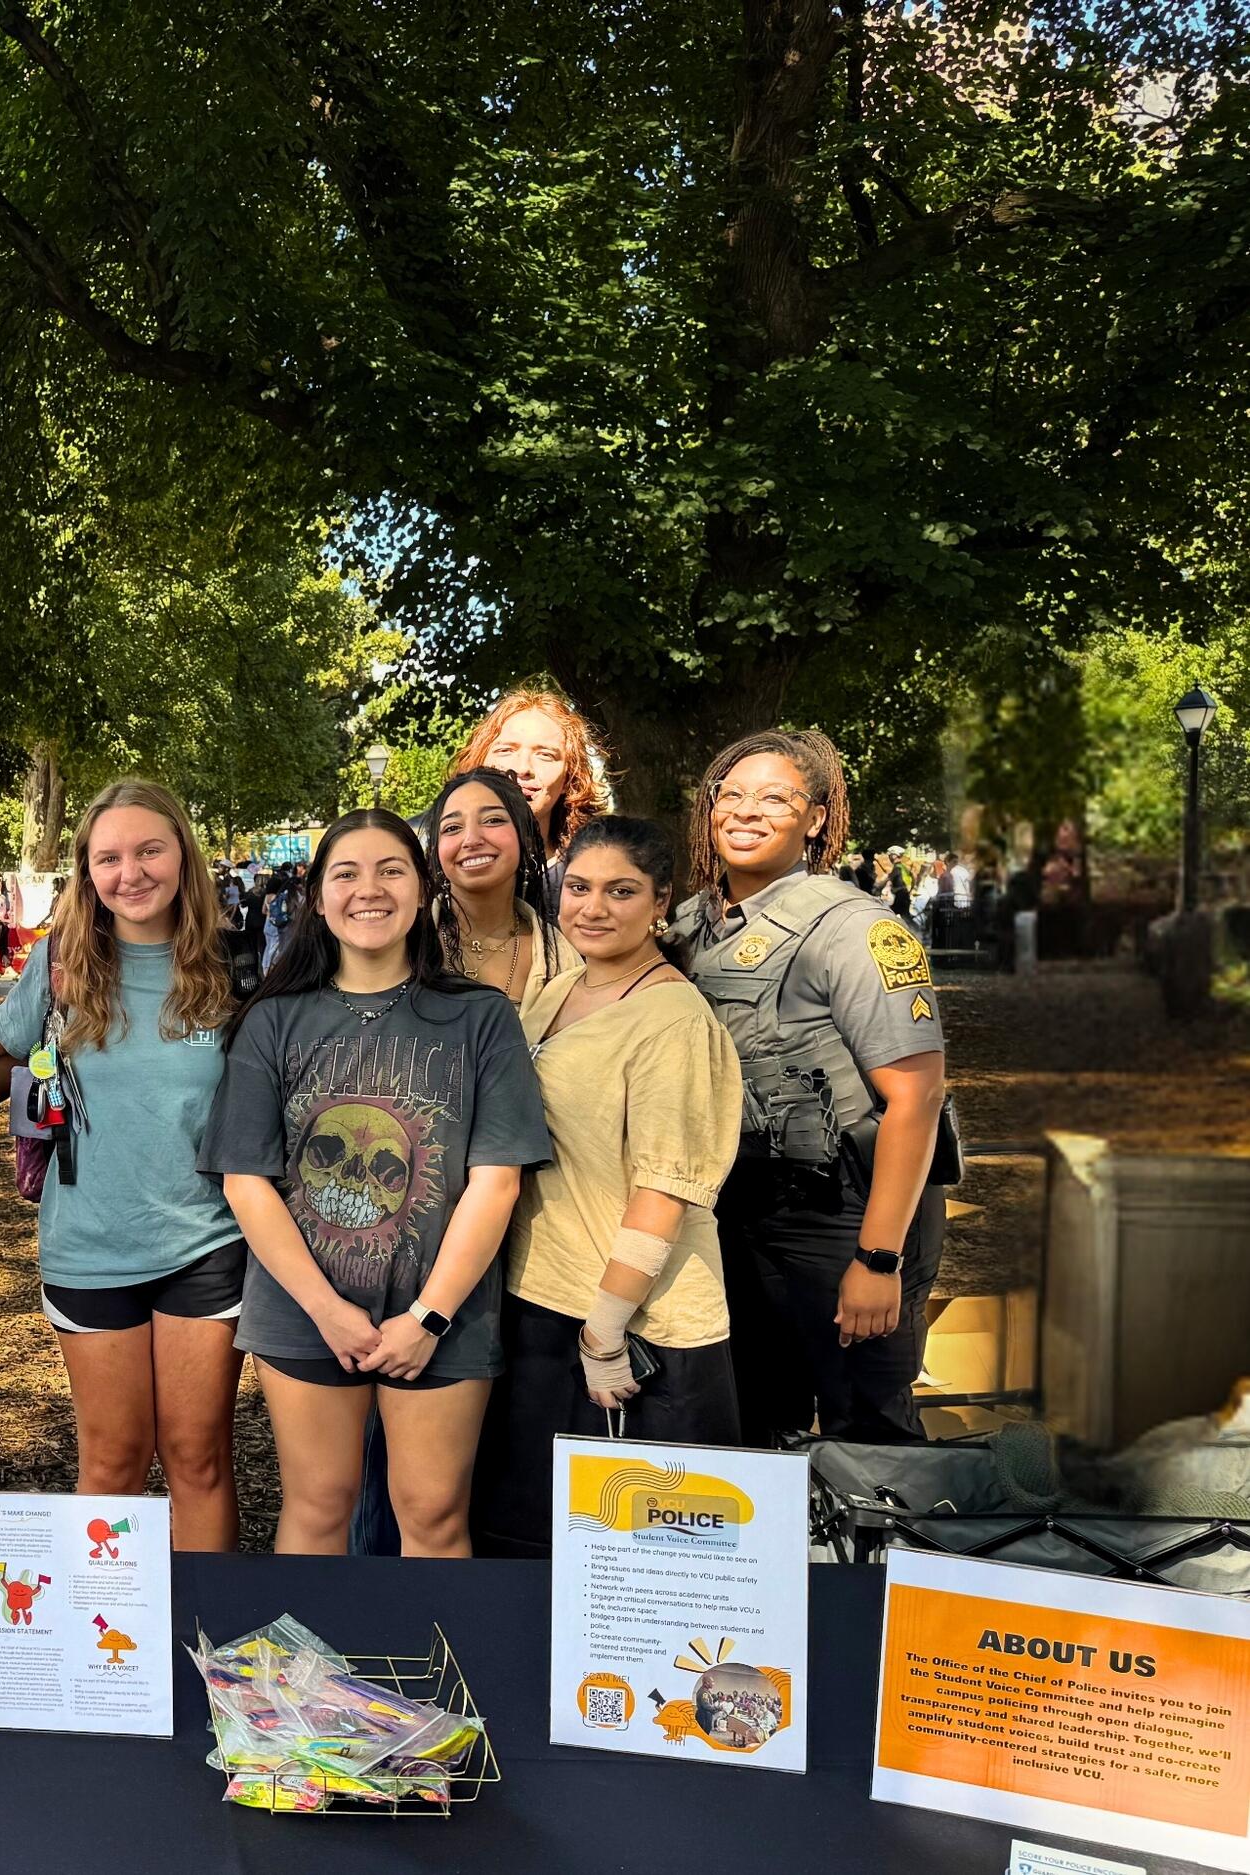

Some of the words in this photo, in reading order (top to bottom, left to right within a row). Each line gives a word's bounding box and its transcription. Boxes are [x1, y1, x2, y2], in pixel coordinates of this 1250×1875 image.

[886, 968, 928, 988] POLICE
[658, 1499, 685, 1509] VCU
[648, 1509, 724, 1529] POLICE
[632, 1532, 664, 1542] Student
[666, 1534, 689, 1544] Voice
[691, 1537, 738, 1548] Committee
[591, 1544, 606, 1552] Help
[653, 1549, 677, 1558] change
[591, 1563, 608, 1572] Bring
[665, 1570, 688, 1579] directly
[737, 1577, 757, 1585] safety
[591, 1573, 625, 1583] leadership
[591, 1593, 615, 1602] Engage
[703, 1603, 717, 1612] help
[642, 1618, 689, 1629] understanding
[590, 1632, 621, 1641] Co-create
[590, 1652, 624, 1660] implement
[977, 1629, 1097, 1668] ABOUT
[1109, 1650, 1156, 1678] US
[583, 1672, 610, 1682] SCAN
[613, 1674, 630, 1683] ME!
[906, 1651, 927, 1663] The
[933, 1655, 968, 1670] Office
[973, 1663, 984, 1673] of
[990, 1666, 1009, 1677] the
[1013, 1669, 1046, 1684] Chief
[1051, 1677, 1062, 1686] of
[1068, 1679, 1106, 1694] Police
[1111, 1686, 1155, 1702] invites
[1160, 1697, 1184, 1707] you
[1189, 1700, 1202, 1710] to
[1207, 1703, 1232, 1715] join
[910, 1668, 929, 1679] the
[934, 1671, 982, 1688] Student
[987, 1680, 1020, 1694] Voice
[1025, 1686, 1094, 1707] Committee
[1099, 1702, 1122, 1712] and
[1127, 1704, 1154, 1720] help
[1159, 1712, 1225, 1729] reimagine
[936, 1687, 984, 1702] campus
[988, 1696, 1038, 1714] policing
[1043, 1704, 1092, 1722] through
[1097, 1716, 1129, 1727] open
[1134, 1720, 1193, 1741] dialogue,
[901, 1693, 981, 1718] transparency
[985, 1710, 1007, 1720] and
[1012, 1713, 1054, 1728] shared
[1058, 1720, 1130, 1744] leadership.
[1134, 1734, 1194, 1755] Together,
[1199, 1748, 1231, 1760] we'll
[908, 1711, 952, 1727] amplify
[957, 1718, 1004, 1734] student
[1009, 1729, 1053, 1745] voices,
[1058, 1735, 1089, 1749] build
[1094, 1741, 1124, 1755] trust
[1130, 1750, 1153, 1760] and
[1158, 1755, 1221, 1772] co-create
[907, 1724, 1037, 1754] community-centered
[1041, 1748, 1106, 1766] strategies
[1109, 1758, 1127, 1770] for
[1145, 1767, 1180, 1782] safer,
[1185, 1775, 1219, 1787] more
[1013, 1755, 1069, 1774] inclusive
[1073, 1766, 1104, 1781] VCU.
[1018, 1850, 1041, 1860] SCORE
[1044, 1857, 1063, 1865] YOUR
[1066, 1862, 1090, 1871] POLICE
